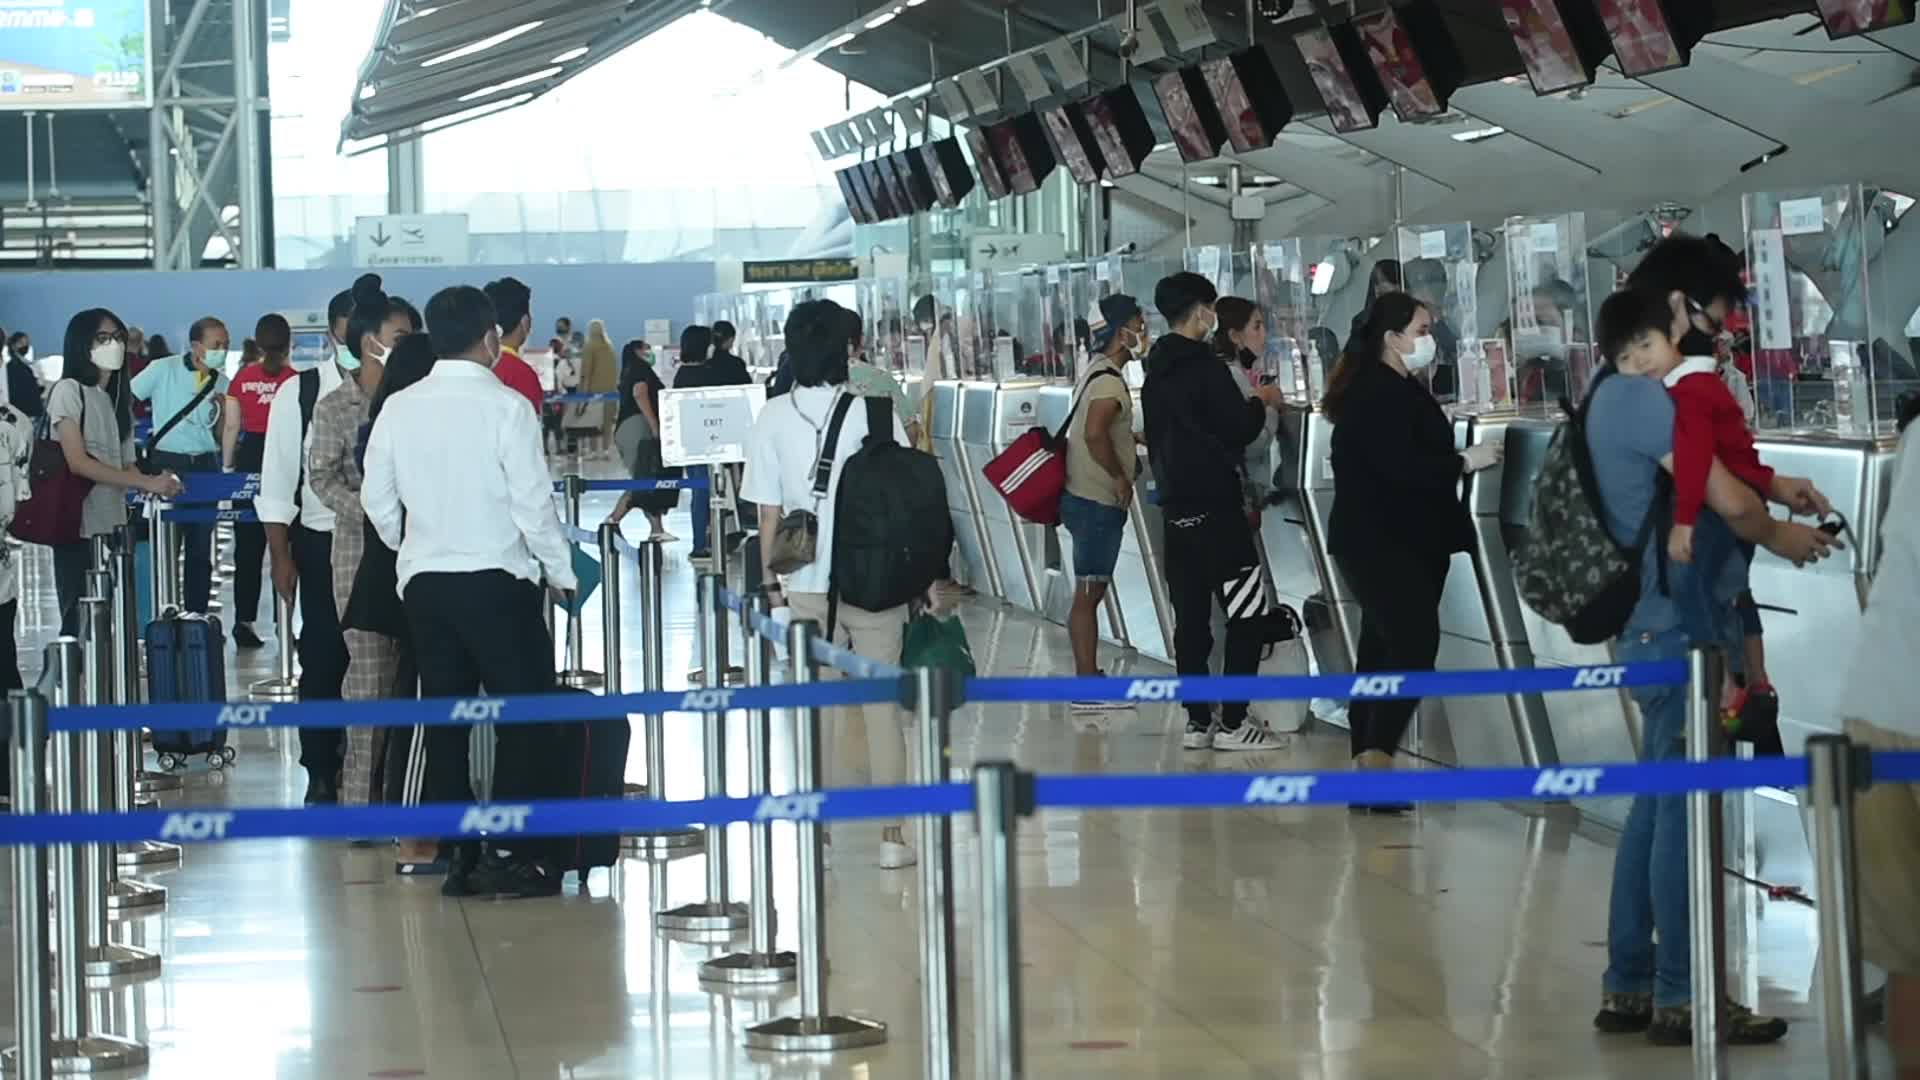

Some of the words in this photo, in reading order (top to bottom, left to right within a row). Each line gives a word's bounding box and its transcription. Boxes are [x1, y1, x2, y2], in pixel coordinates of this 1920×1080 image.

[703, 418, 723, 427] EXIT
[655, 479, 679, 489] AOT
[1351, 676, 1404, 696] AOT
[1573, 667, 1625, 687] AOT
[680, 688, 736, 710] AOT
[1126, 679, 1181, 700] AOT
[217, 704, 272, 725] AOT
[450, 699, 506, 720] AOT
[1246, 776, 1315, 802] AOT
[1534, 769, 1602, 795] AOT
[754, 793, 827, 819] AOT
[161, 812, 233, 839] AOT
[461, 805, 532, 832] AOT
